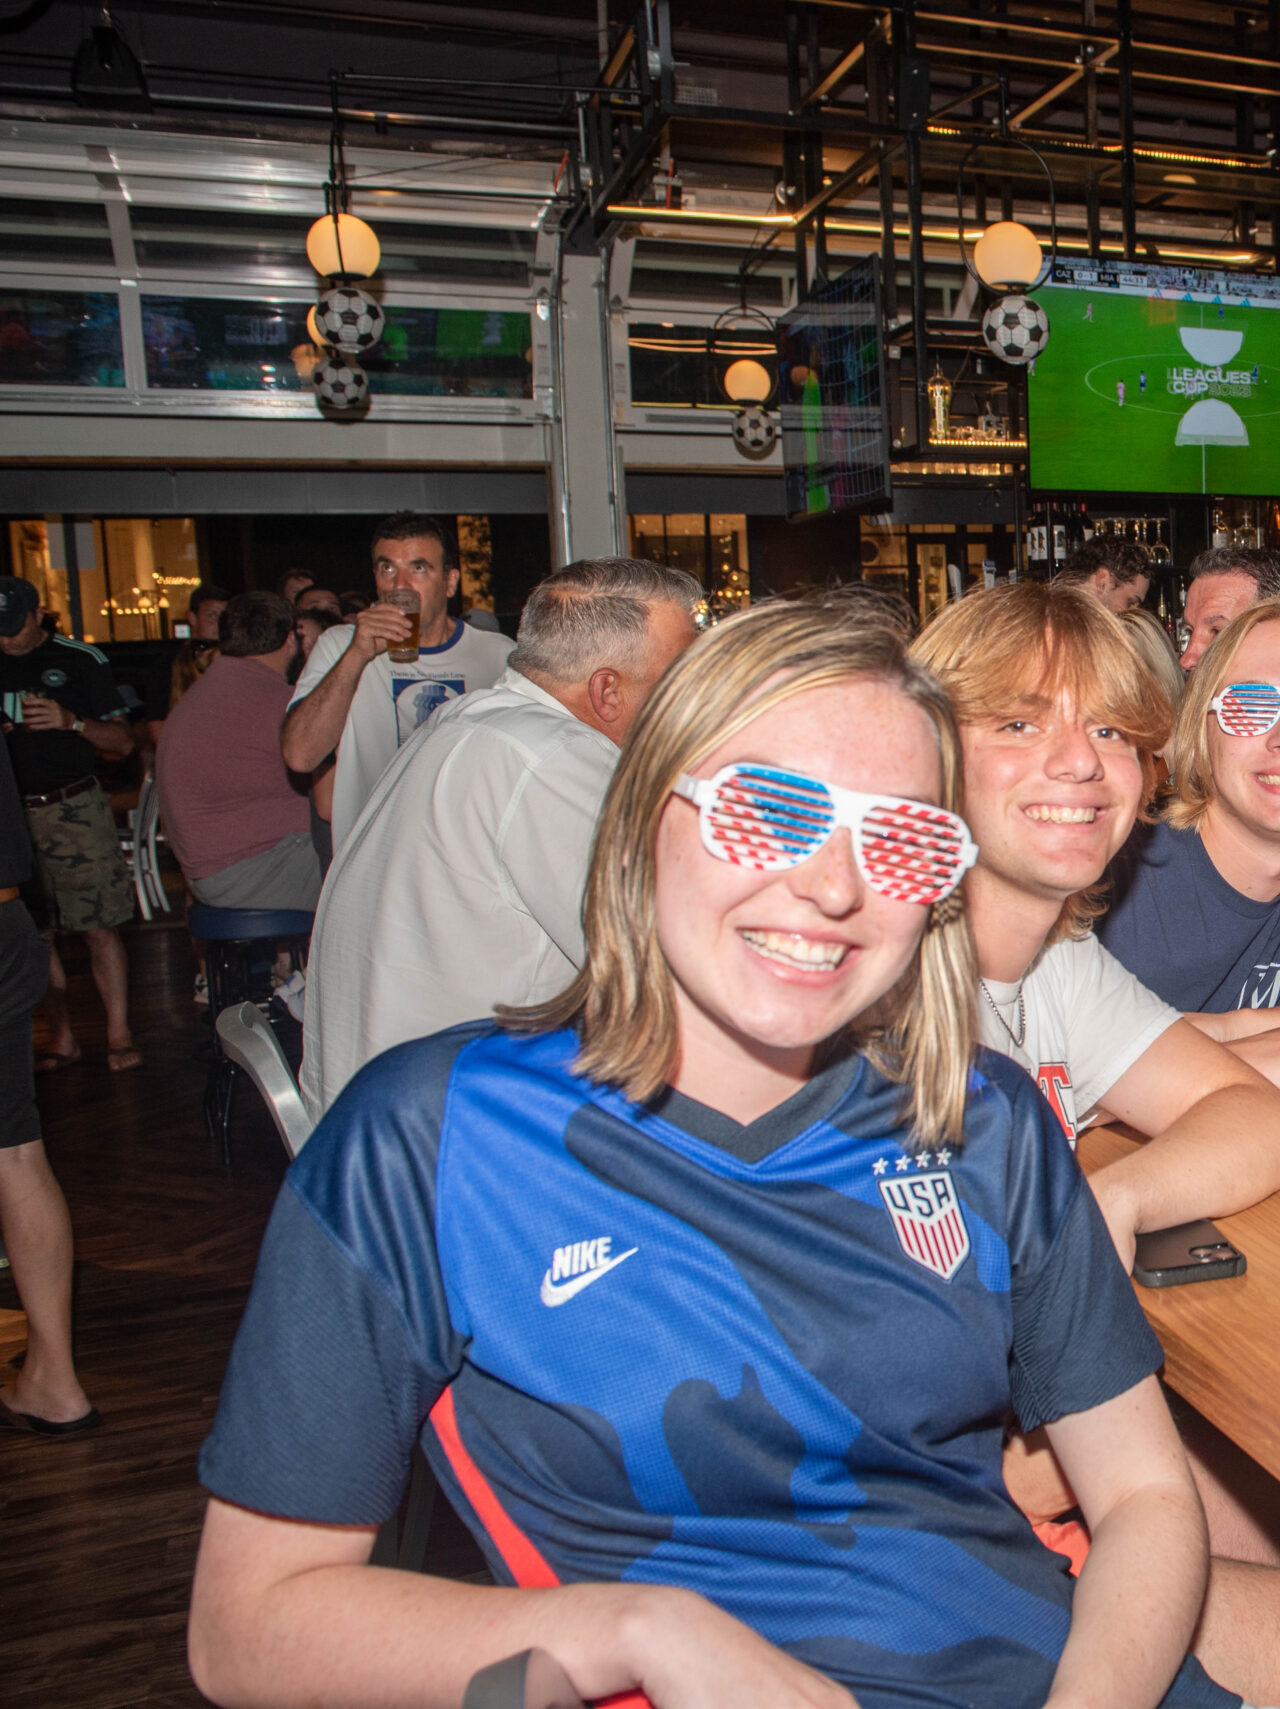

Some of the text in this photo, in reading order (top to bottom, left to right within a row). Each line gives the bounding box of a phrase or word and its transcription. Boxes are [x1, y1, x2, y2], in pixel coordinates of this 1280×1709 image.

[1172, 367, 1251, 385] LEAGUES
[1172, 380, 1209, 396] CUP
[893, 1177, 952, 1218] USA
[552, 1236, 612, 1282] NIKE
